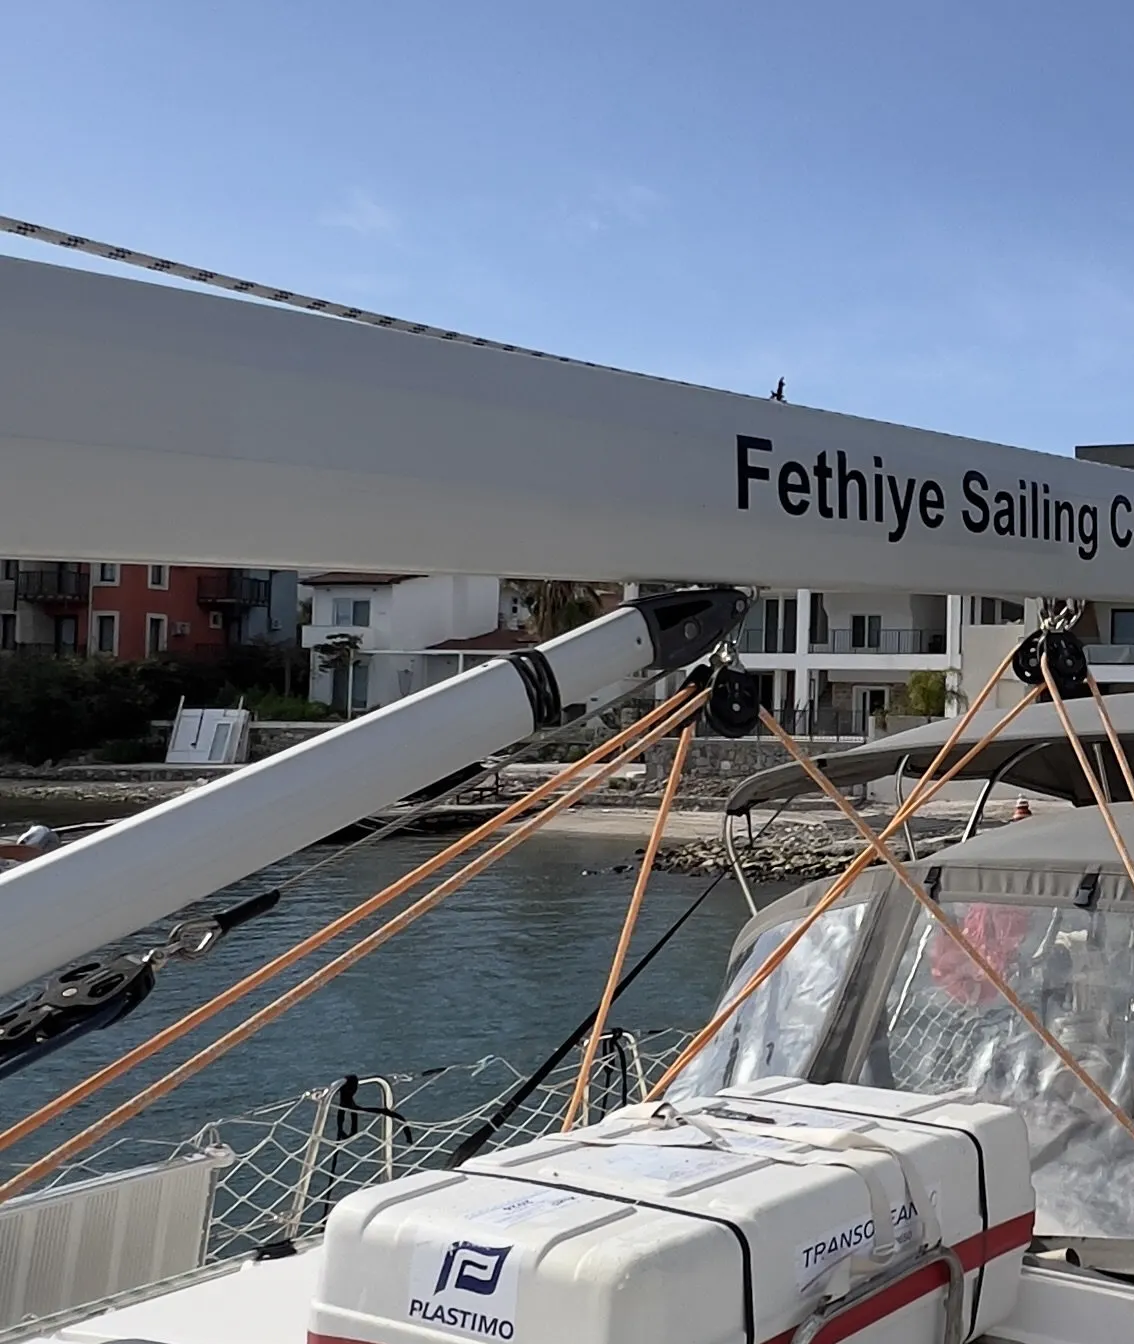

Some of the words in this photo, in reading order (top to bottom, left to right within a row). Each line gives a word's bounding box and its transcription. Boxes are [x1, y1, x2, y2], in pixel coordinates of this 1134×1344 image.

[736, 434, 946, 543] Fethiye
[961, 470, 1098, 561] Sailing
[408, 1298, 515, 1340] PLASTIMO
